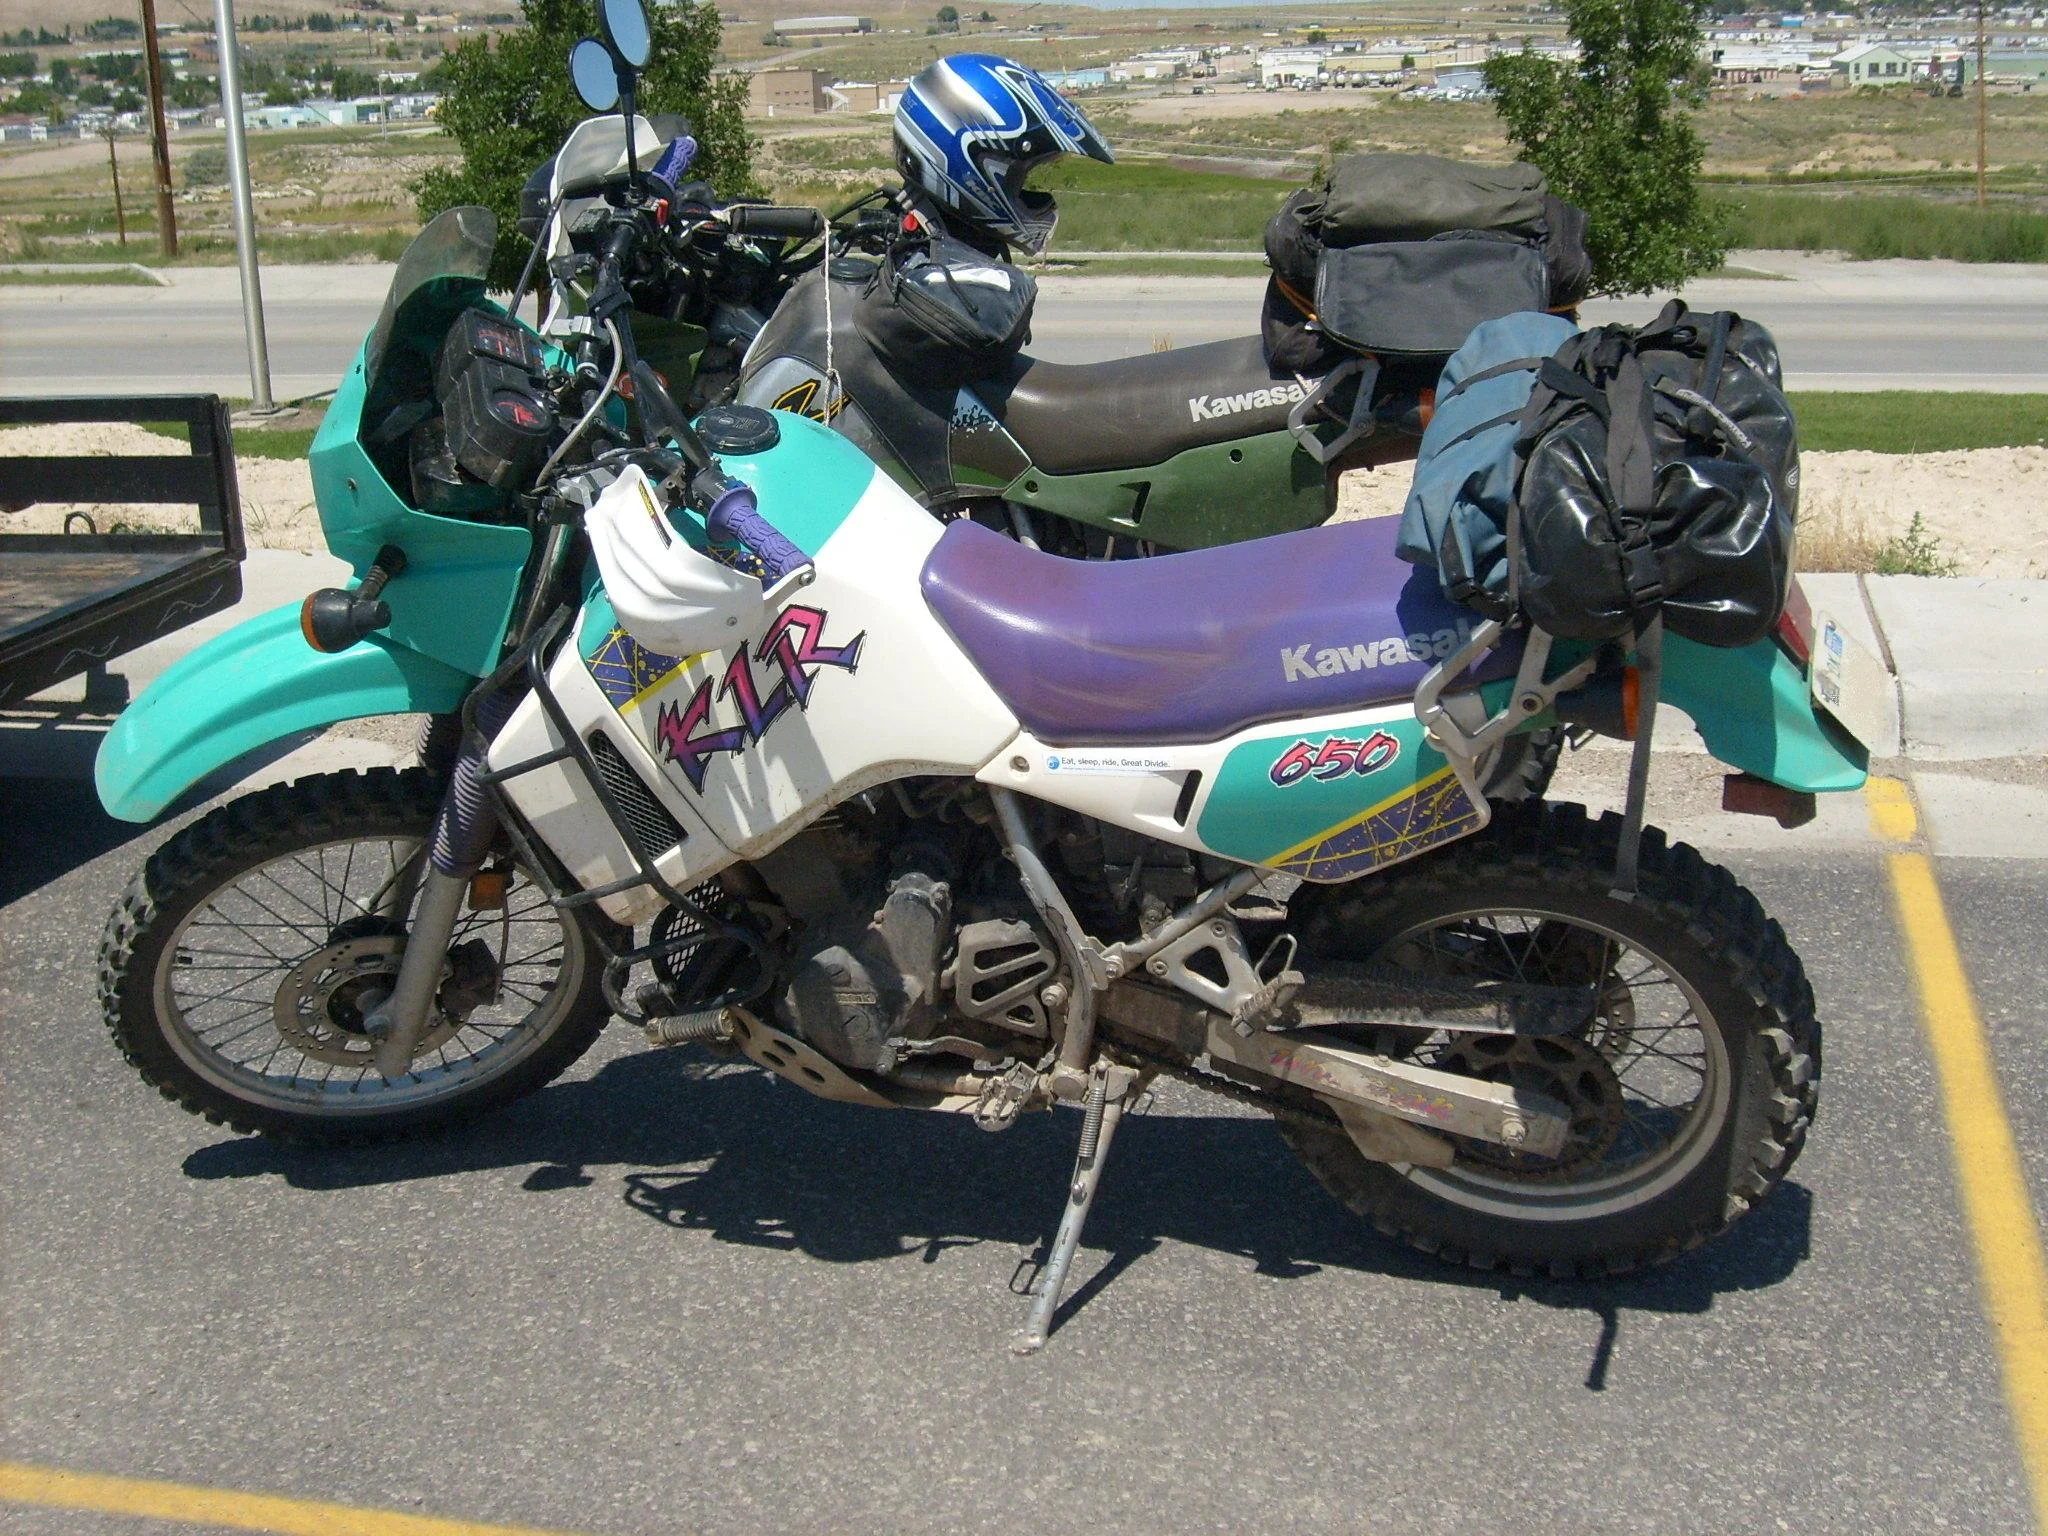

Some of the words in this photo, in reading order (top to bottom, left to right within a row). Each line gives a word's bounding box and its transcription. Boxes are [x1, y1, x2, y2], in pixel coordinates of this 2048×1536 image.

[654, 604, 867, 798] KLR
[1061, 757, 1076, 766] Eat,
[1078, 757, 1101, 767] sleep,
[1102, 758, 1120, 767] ride,
[1121, 758, 1143, 767] Great
[1144, 759, 1171, 768] Divide.
[1269, 729, 1401, 788] 650
